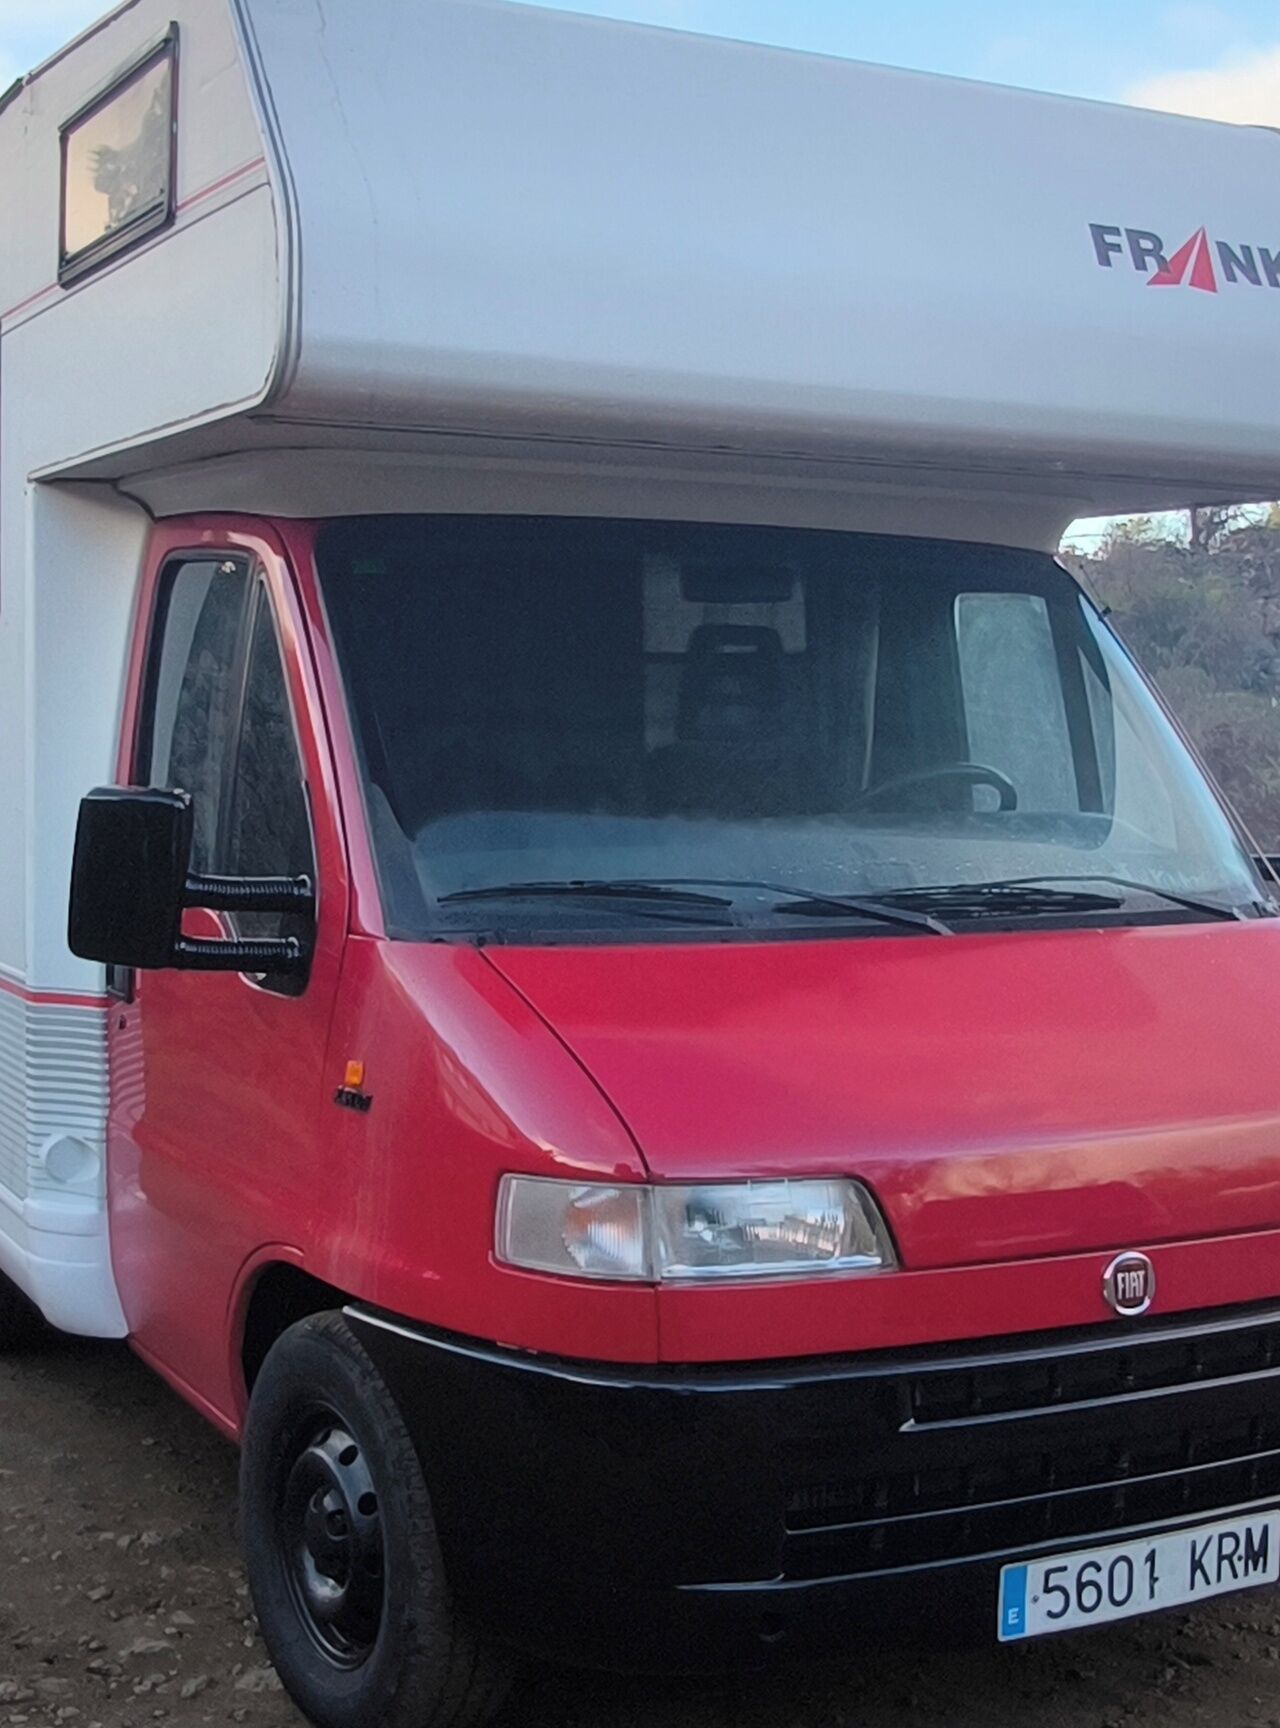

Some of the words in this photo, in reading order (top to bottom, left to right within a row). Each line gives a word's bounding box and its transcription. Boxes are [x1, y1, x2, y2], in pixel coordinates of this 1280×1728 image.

[1116, 1269, 1145, 1301] FIAT
[1007, 1607, 1019, 1625] E
[1042, 1548, 1160, 1620] 5601
[1188, 1523, 1270, 1591] KRM
